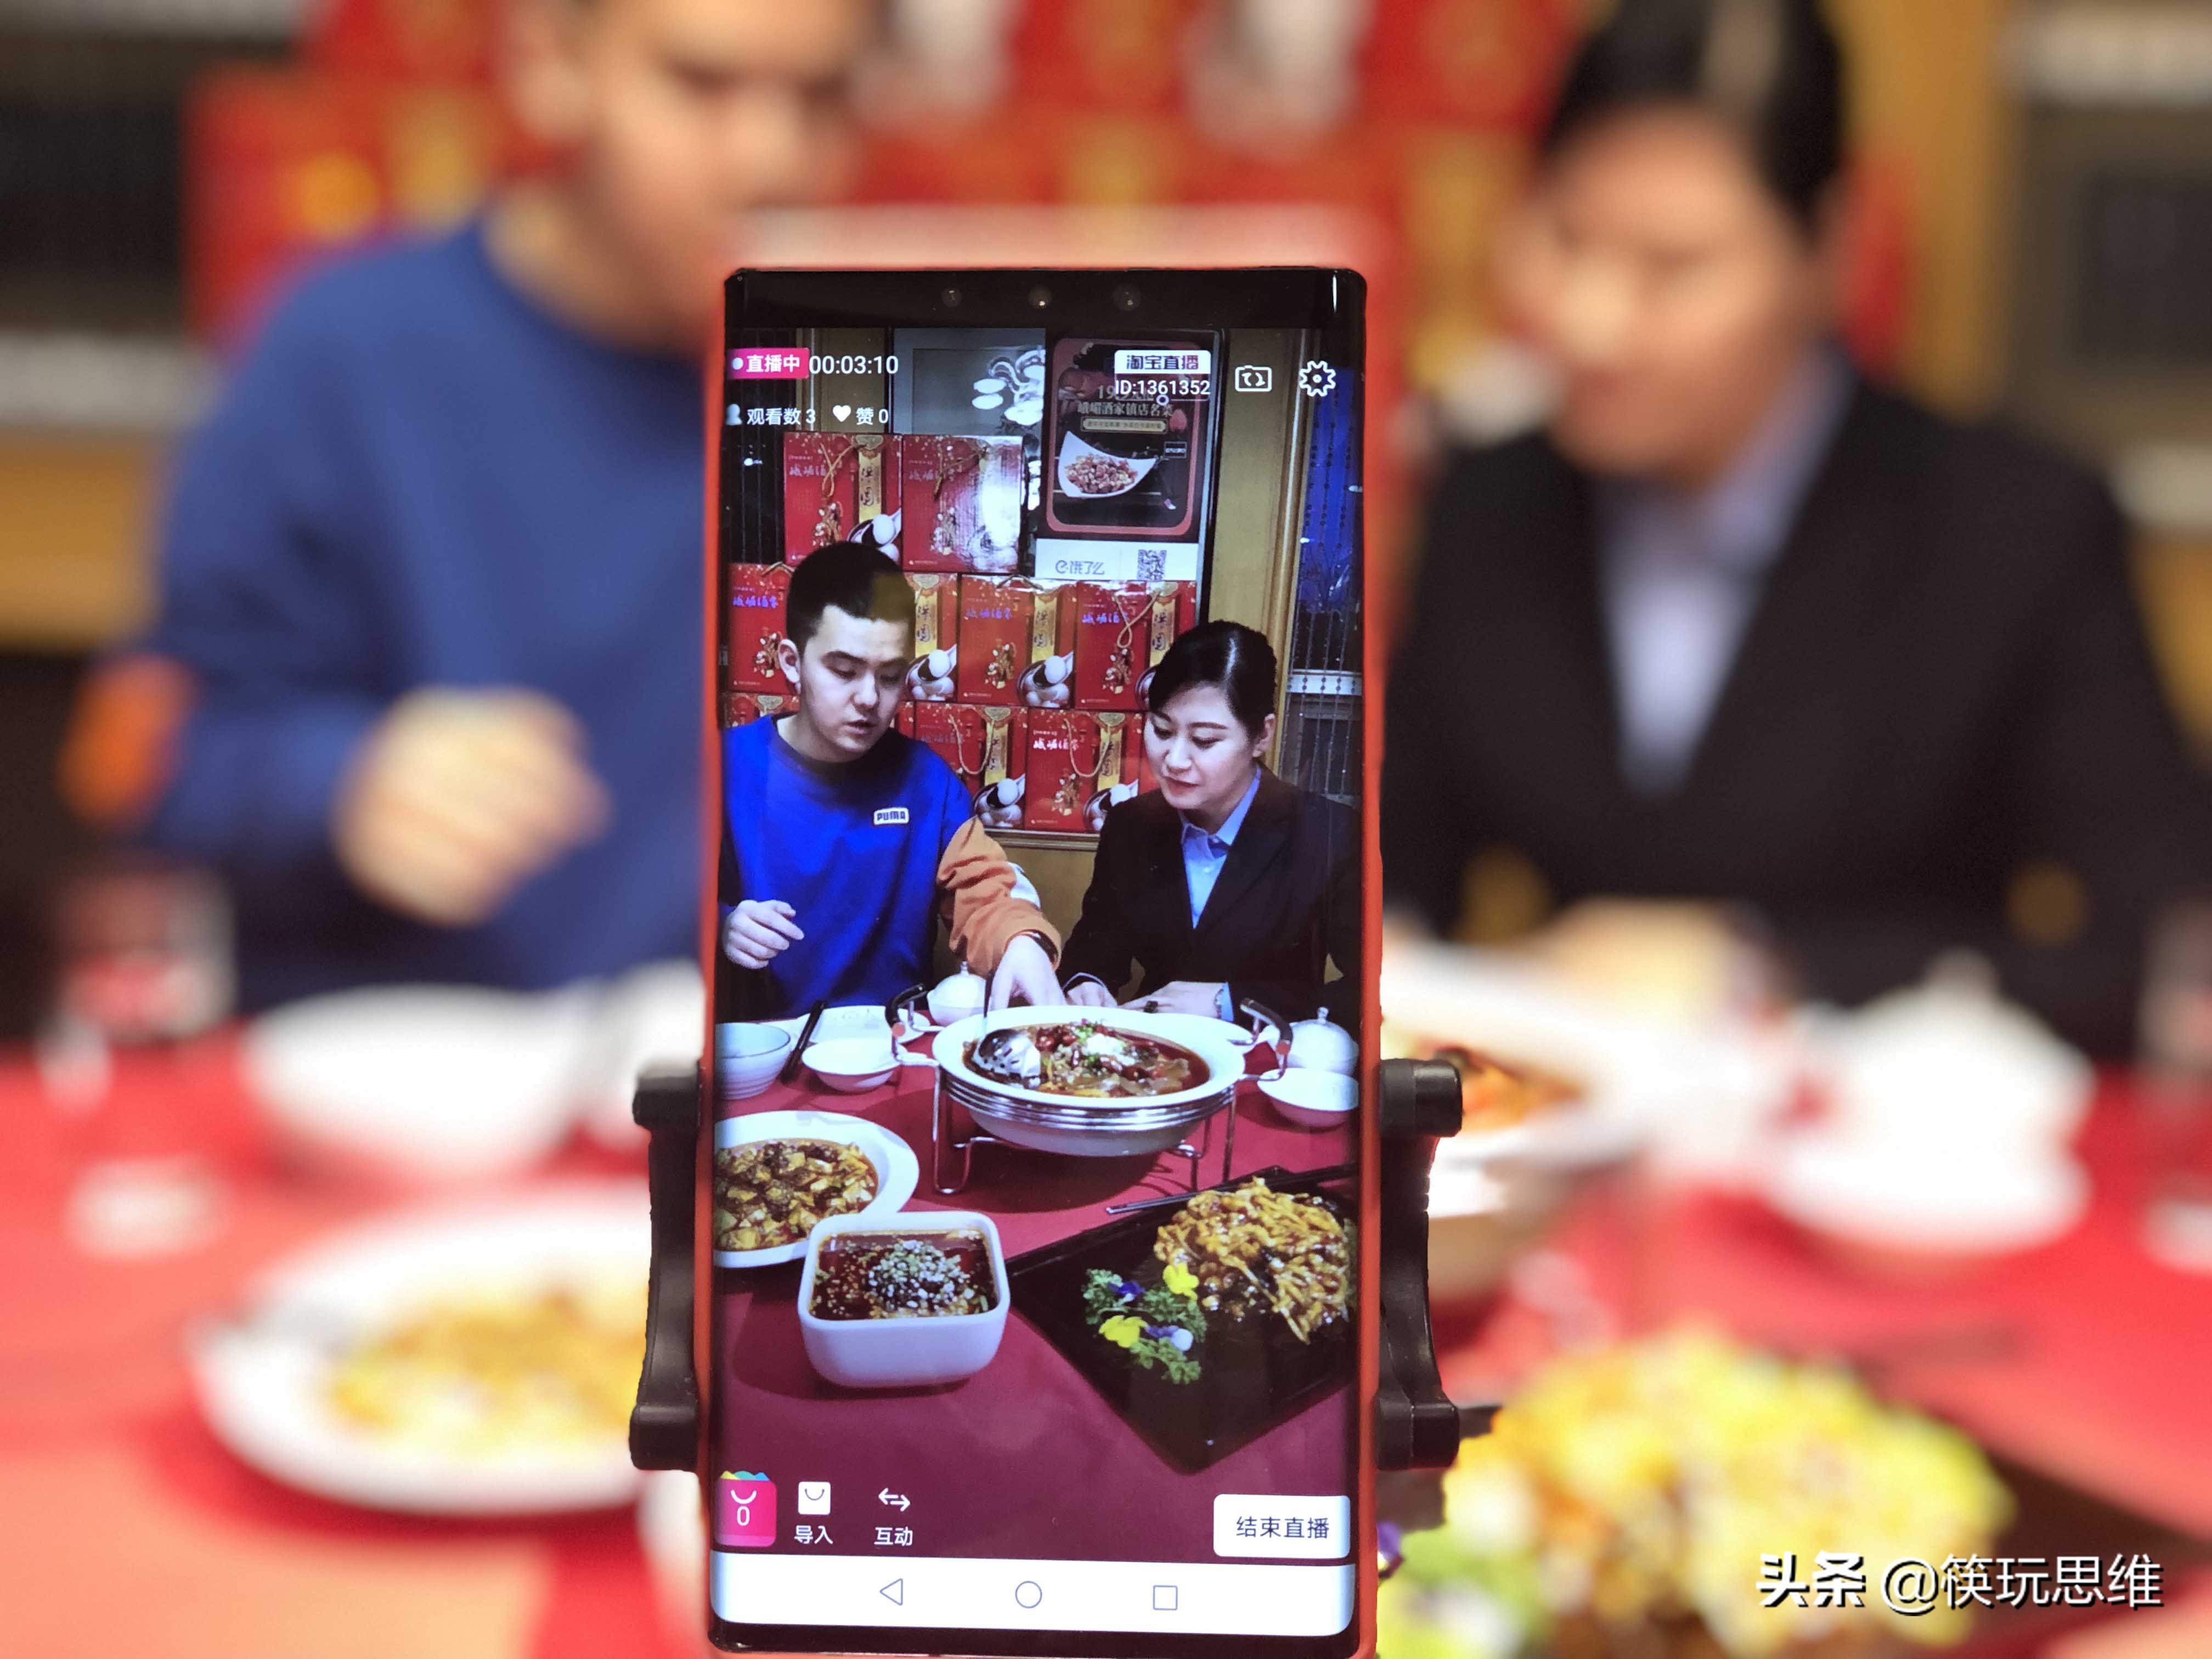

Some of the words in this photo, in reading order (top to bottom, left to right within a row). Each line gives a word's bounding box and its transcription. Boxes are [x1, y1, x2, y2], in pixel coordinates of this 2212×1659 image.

[746, 354, 800, 373] 直播中
[809, 356, 899, 374] 00:03:10
[1126, 355, 1199, 370] 淘宝直播
[1115, 380, 1211, 395] ID:1361352
[747, 408, 801, 425] 观看数
[806, 409, 816, 424] 3
[856, 408, 873, 425] 赞
[879, 409, 889, 424] 0
[877, 811, 906, 821] PUMA
[794, 1525, 833, 1544] 导入
[874, 1526, 913, 1547] 互动
[1236, 1516, 1330, 1539] 结束直播
